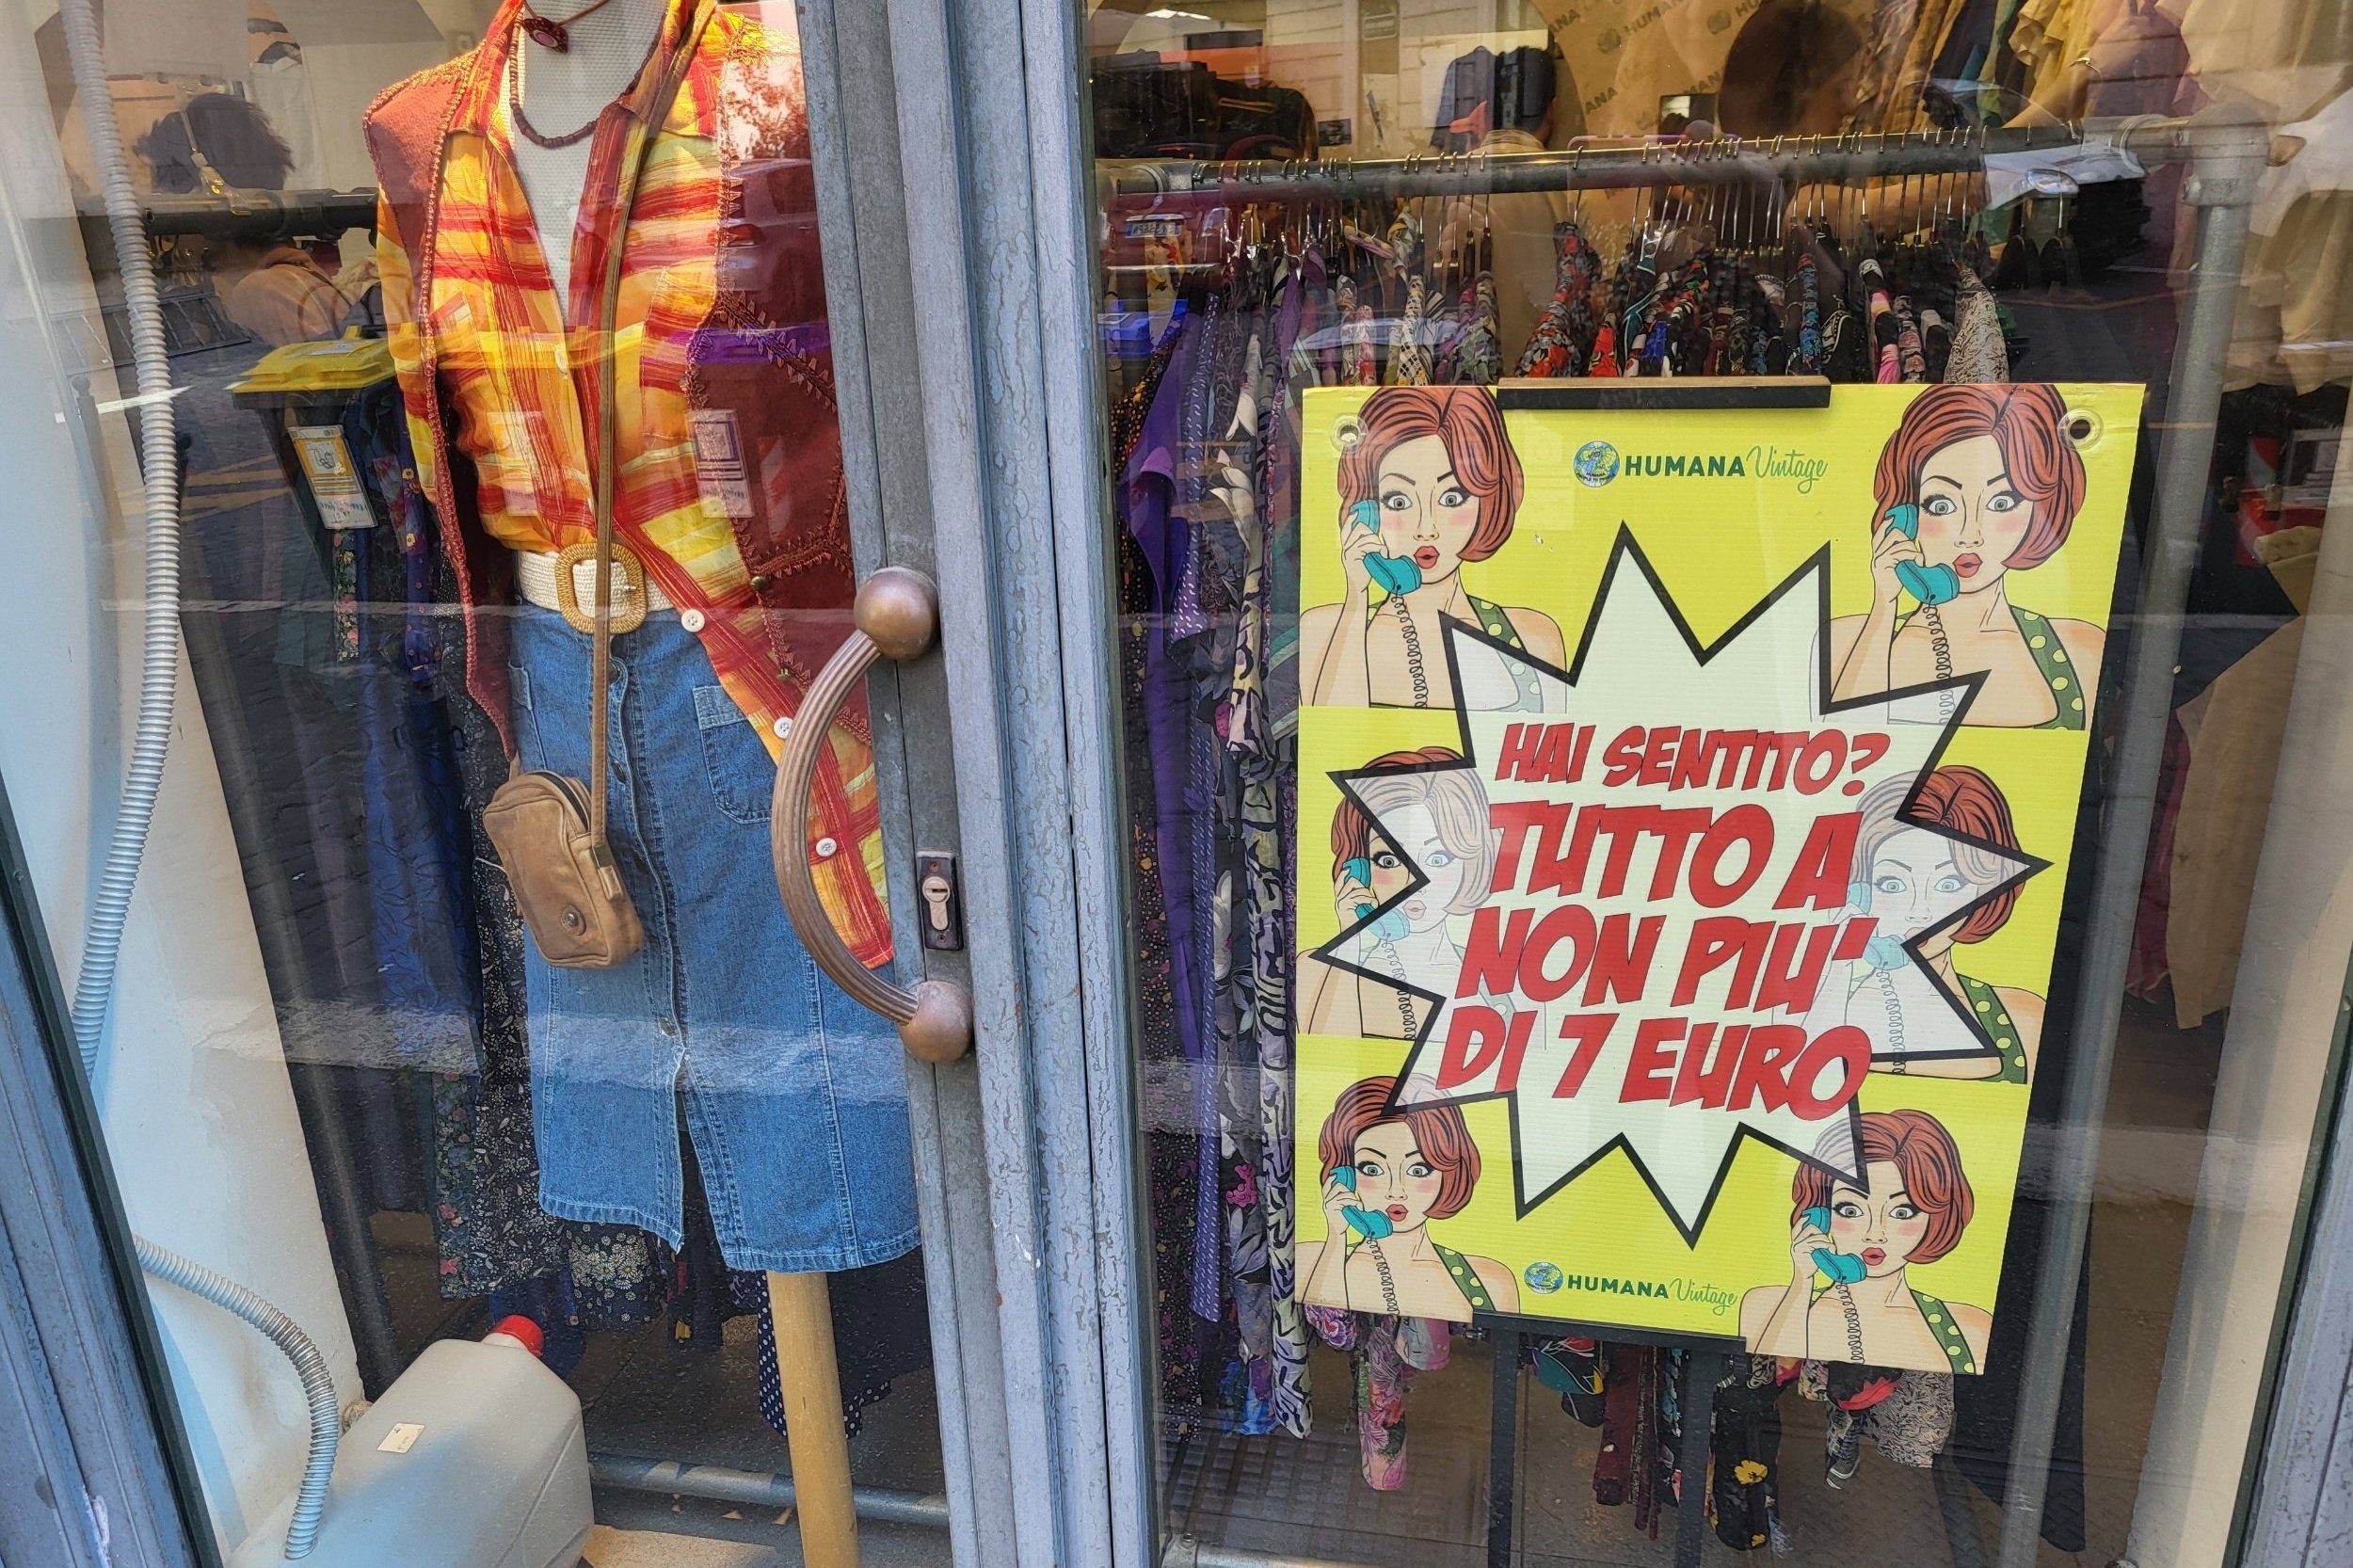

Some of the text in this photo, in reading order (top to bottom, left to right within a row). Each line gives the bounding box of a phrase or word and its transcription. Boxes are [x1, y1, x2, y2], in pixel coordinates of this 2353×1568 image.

[1625, 445, 1828, 494] HUMANA Vintage
[1495, 723, 1891, 796] HAI SENTITO?
[1488, 800, 1864, 910] TUTTO A
[1455, 904, 1879, 1015] NON PIU'
[1435, 1005, 1872, 1121] DI 7 EURO
[1567, 1274, 1738, 1316] HUMANA Vintage
